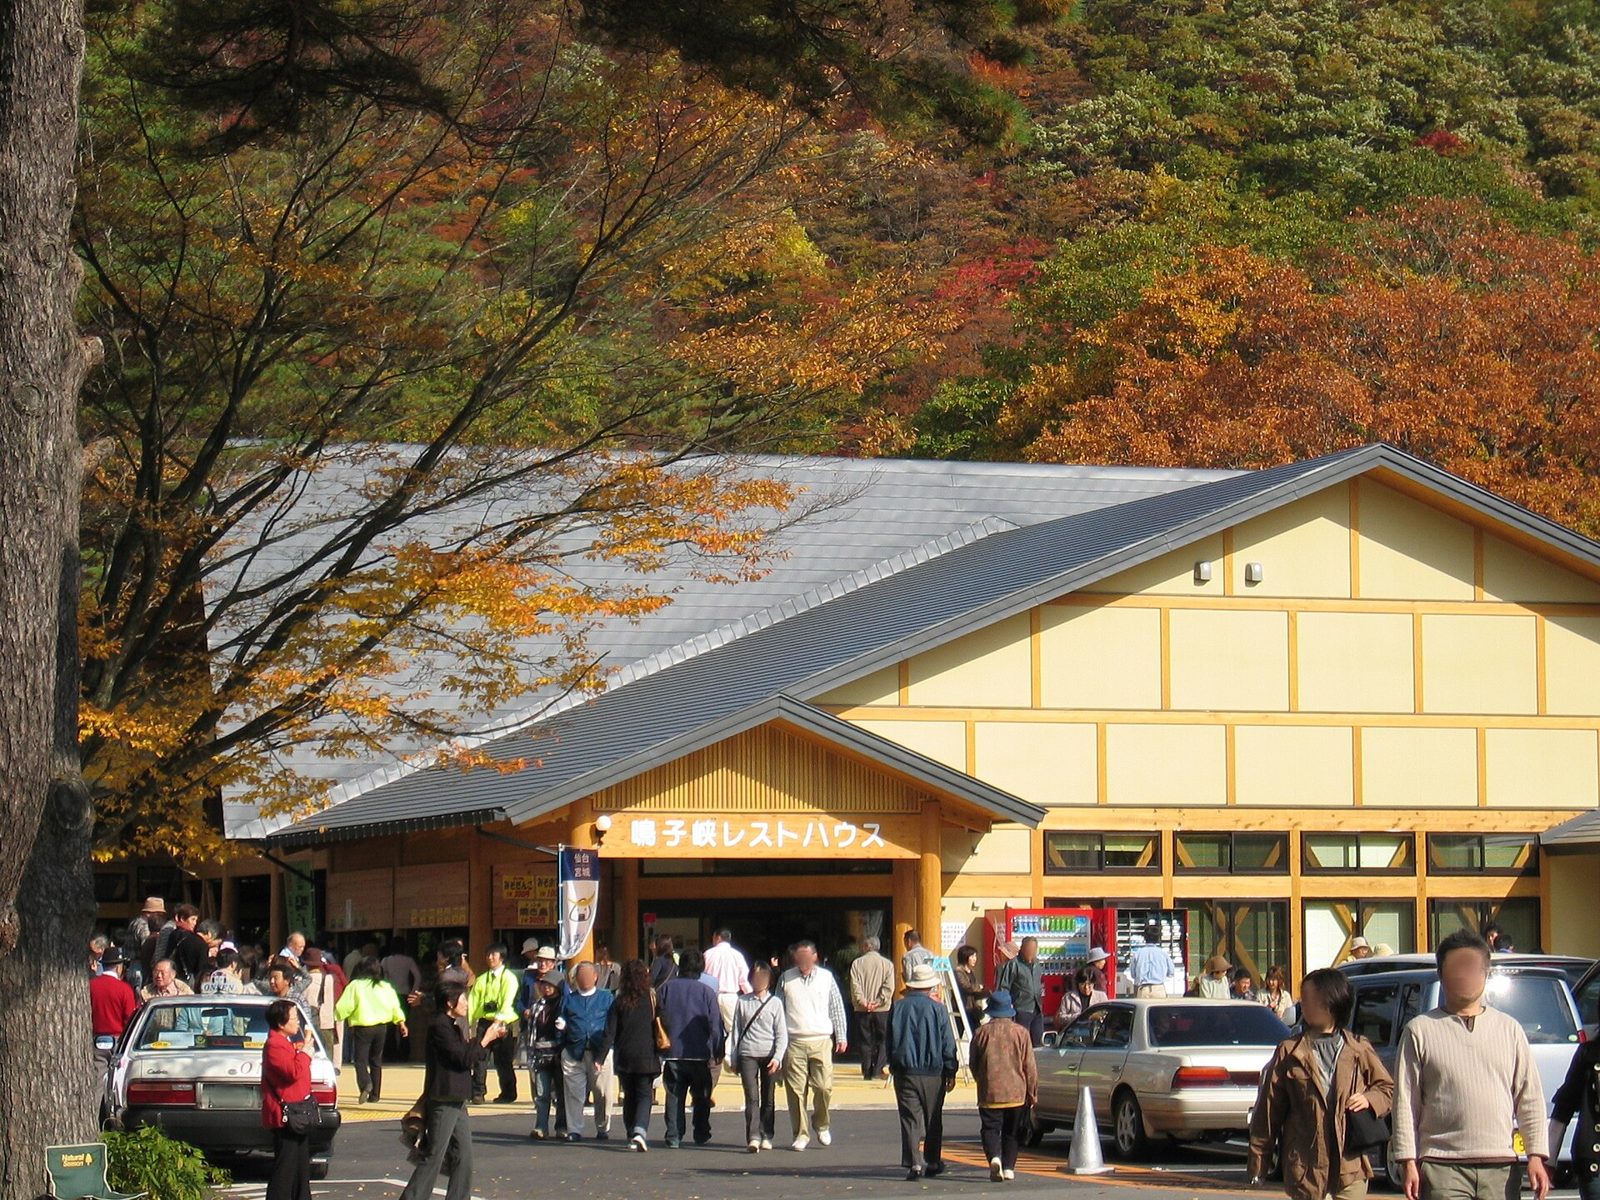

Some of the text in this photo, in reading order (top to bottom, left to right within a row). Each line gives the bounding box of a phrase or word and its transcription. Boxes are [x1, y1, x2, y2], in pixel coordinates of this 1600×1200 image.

[630, 818, 886, 848] 鳴子峡レストハウス
